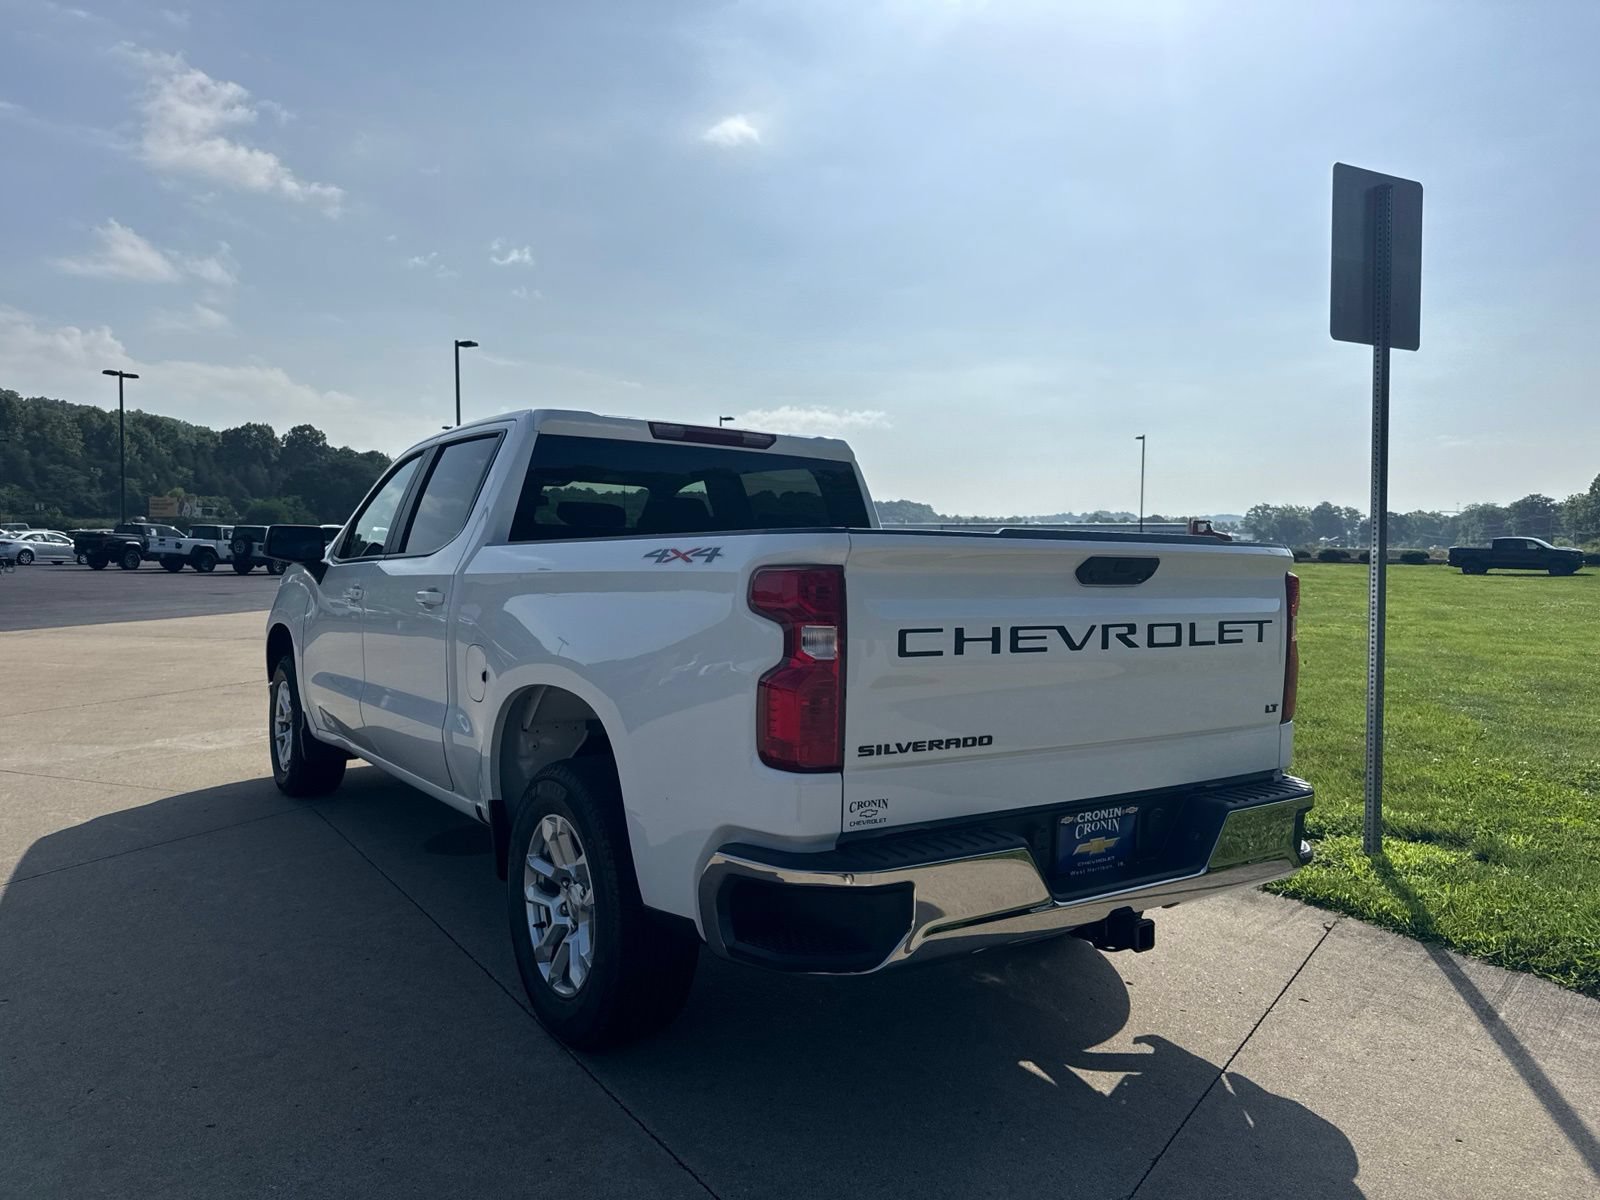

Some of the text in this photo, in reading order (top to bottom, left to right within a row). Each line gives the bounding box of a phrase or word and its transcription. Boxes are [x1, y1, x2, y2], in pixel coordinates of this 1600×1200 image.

[898, 619, 1272, 658] CHEVROLET
[1265, 703, 1279, 714] LT
[857, 735, 993, 758] SILVERADO
[849, 798, 889, 814] CRONIN
[849, 817, 887, 827] CHEVROLET
[1077, 807, 1122, 823] CRONIN
[1075, 818, 1120, 839] CRONIN
[1077, 856, 1115, 867] CHEVROLET
